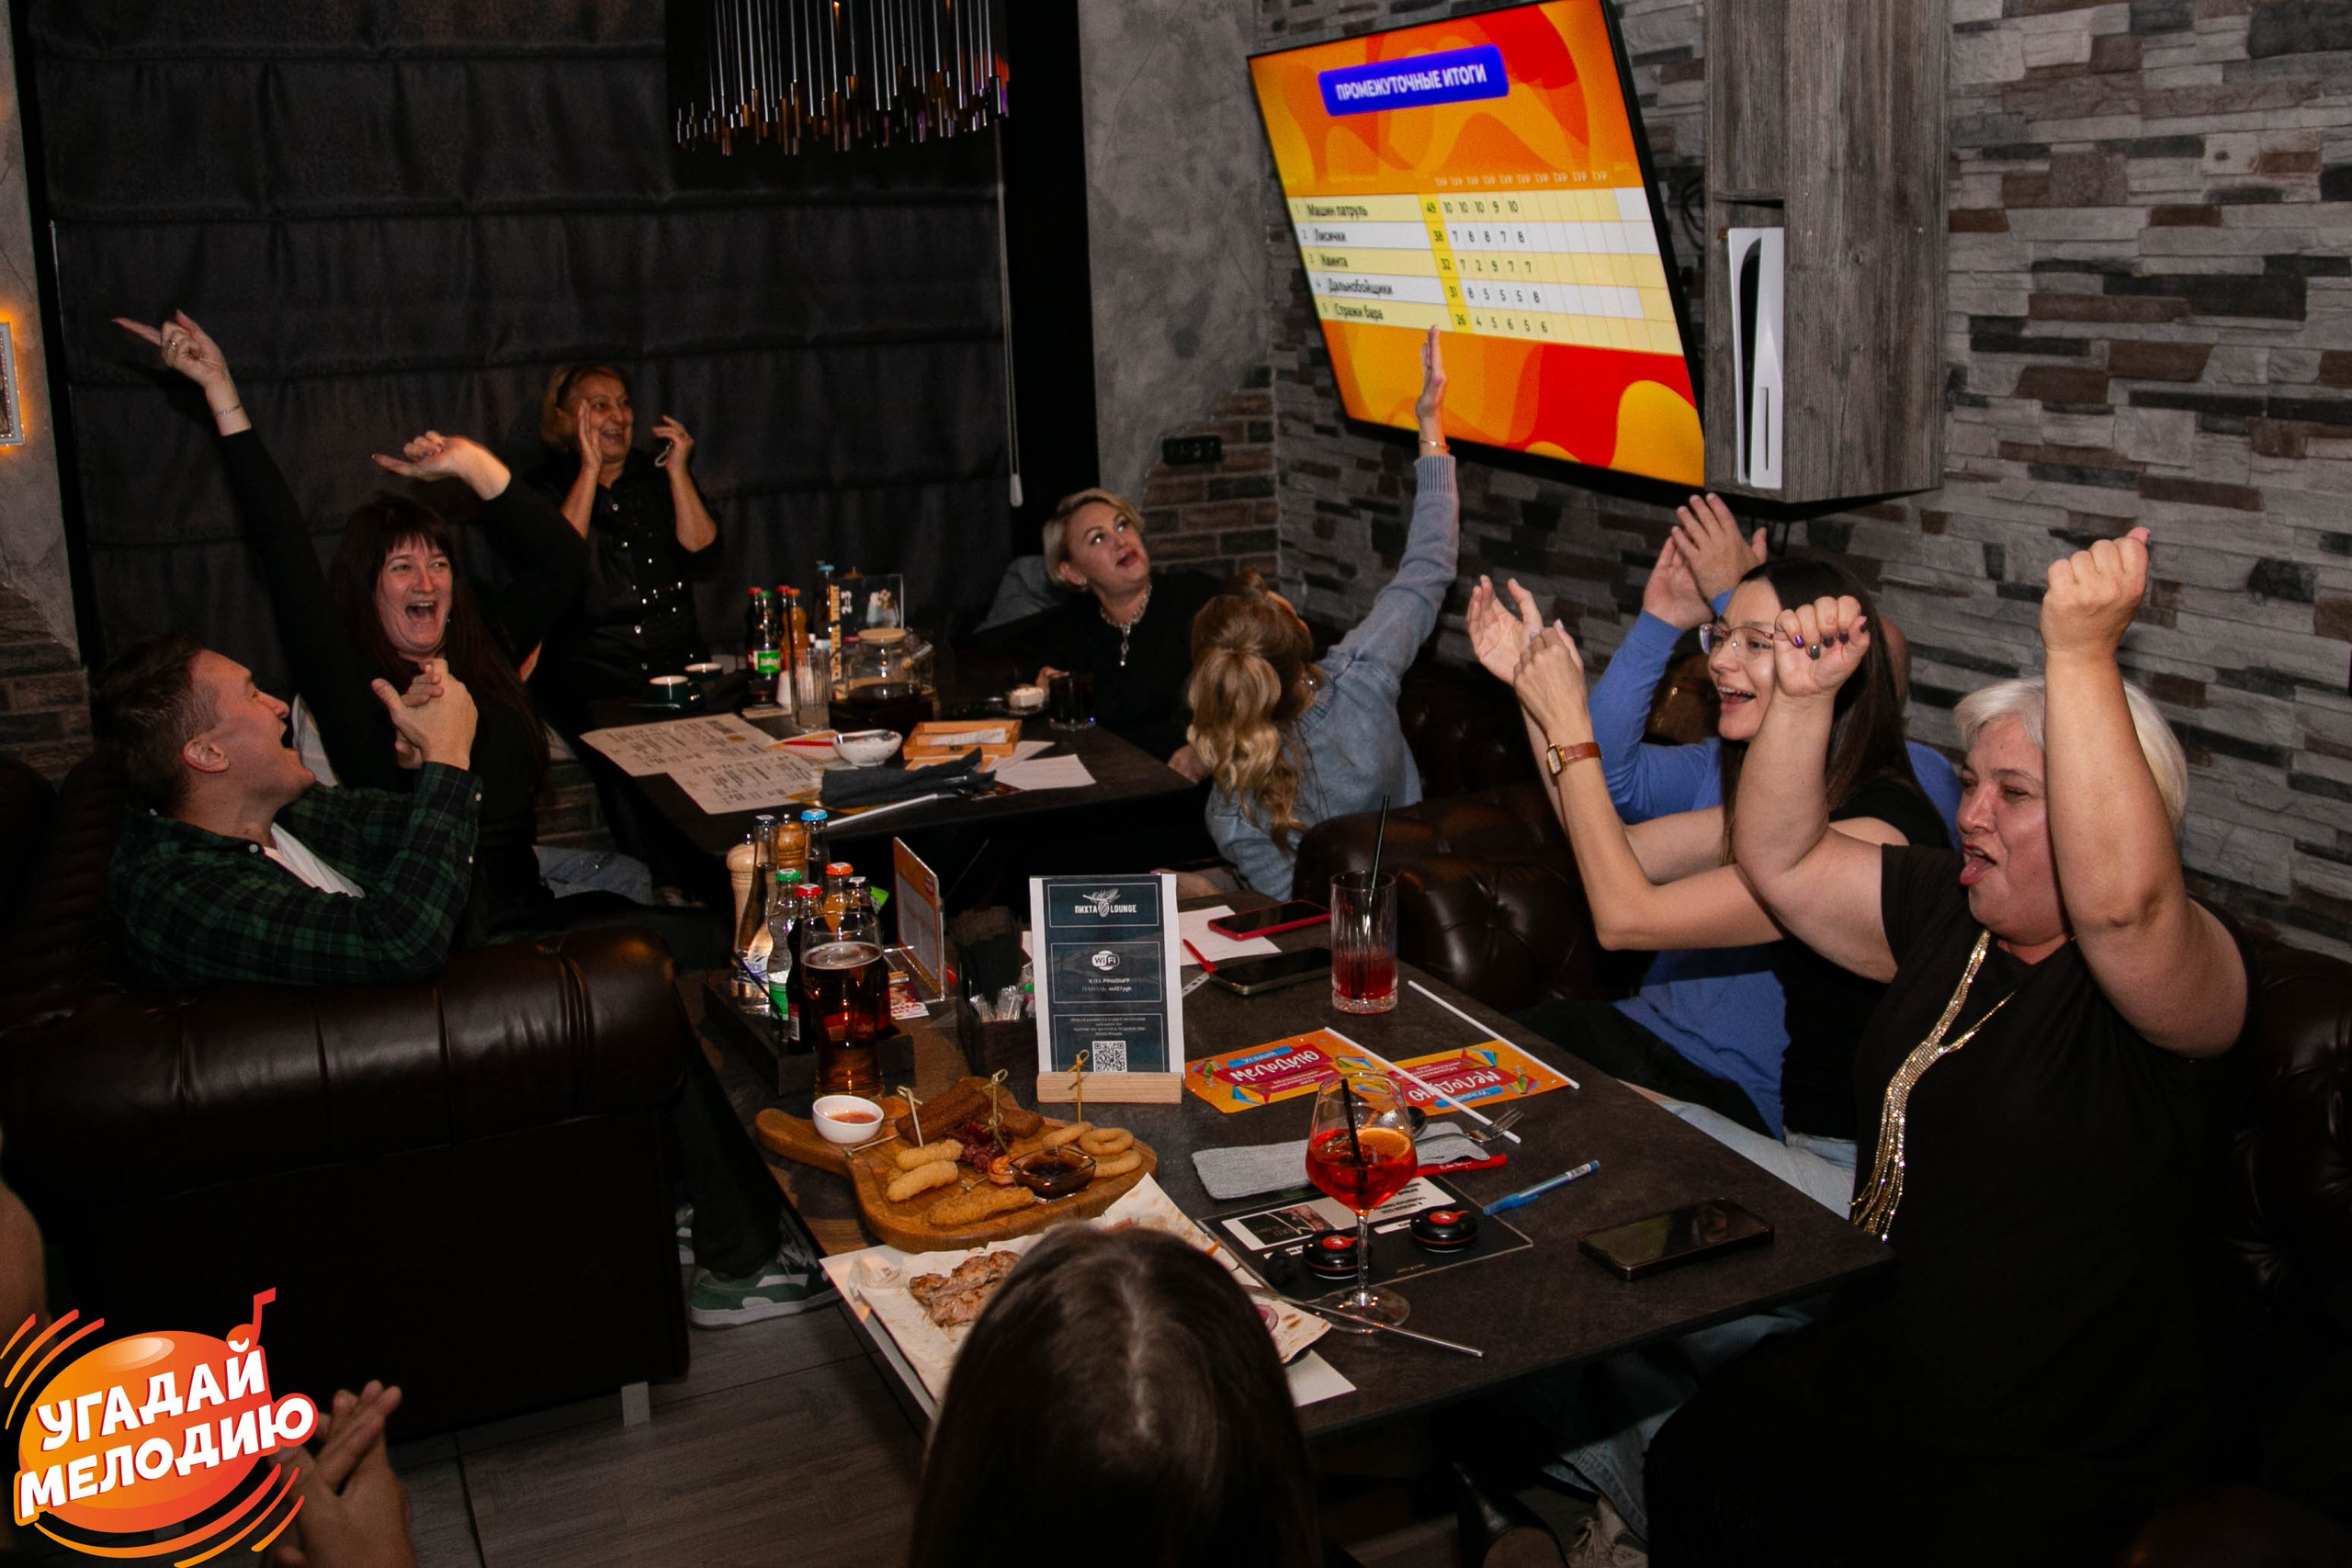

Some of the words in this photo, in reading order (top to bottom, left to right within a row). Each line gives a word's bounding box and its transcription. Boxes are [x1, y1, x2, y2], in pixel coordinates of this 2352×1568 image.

[1336, 70, 1442, 101] ПРОМЕЖУТОЧНЫЕ
[1442, 63, 1487, 87] ИТОГИ
[1336, 205, 1368, 219] патруль
[1443, 201, 1453, 213] 10
[1459, 201, 1468, 213] 10
[1475, 201, 1485, 213] 10
[1493, 200, 1499, 212] 9
[1508, 200, 1519, 212] 10
[1453, 231, 1459, 242] 7
[1500, 231, 1507, 243] 7
[1518, 231, 1525, 243] 8
[1441, 258, 1452, 270] 32
[1460, 259, 1465, 271] 7
[1476, 259, 1482, 272] 2
[1492, 260, 1498, 272] 9
[1509, 260, 1514, 273] 7
[1526, 261, 1532, 273] 7
[1329, 277, 1394, 296] Дальнобойщики
[1484, 288, 1490, 299] 5
[1499, 289, 1506, 301] 5
[1517, 290, 1523, 302] 5
[1533, 291, 1541, 303] 8
[1363, 304, 1385, 321] бара
[1476, 316, 1482, 327] 4
[1491, 317, 1498, 329] 5
[1508, 319, 1514, 330] 6
[1524, 320, 1532, 332] 5
[1542, 321, 1548, 333] 6
[1074, 905, 1098, 914] ПИХТА
[1110, 904, 1137, 913] LOUNGE
